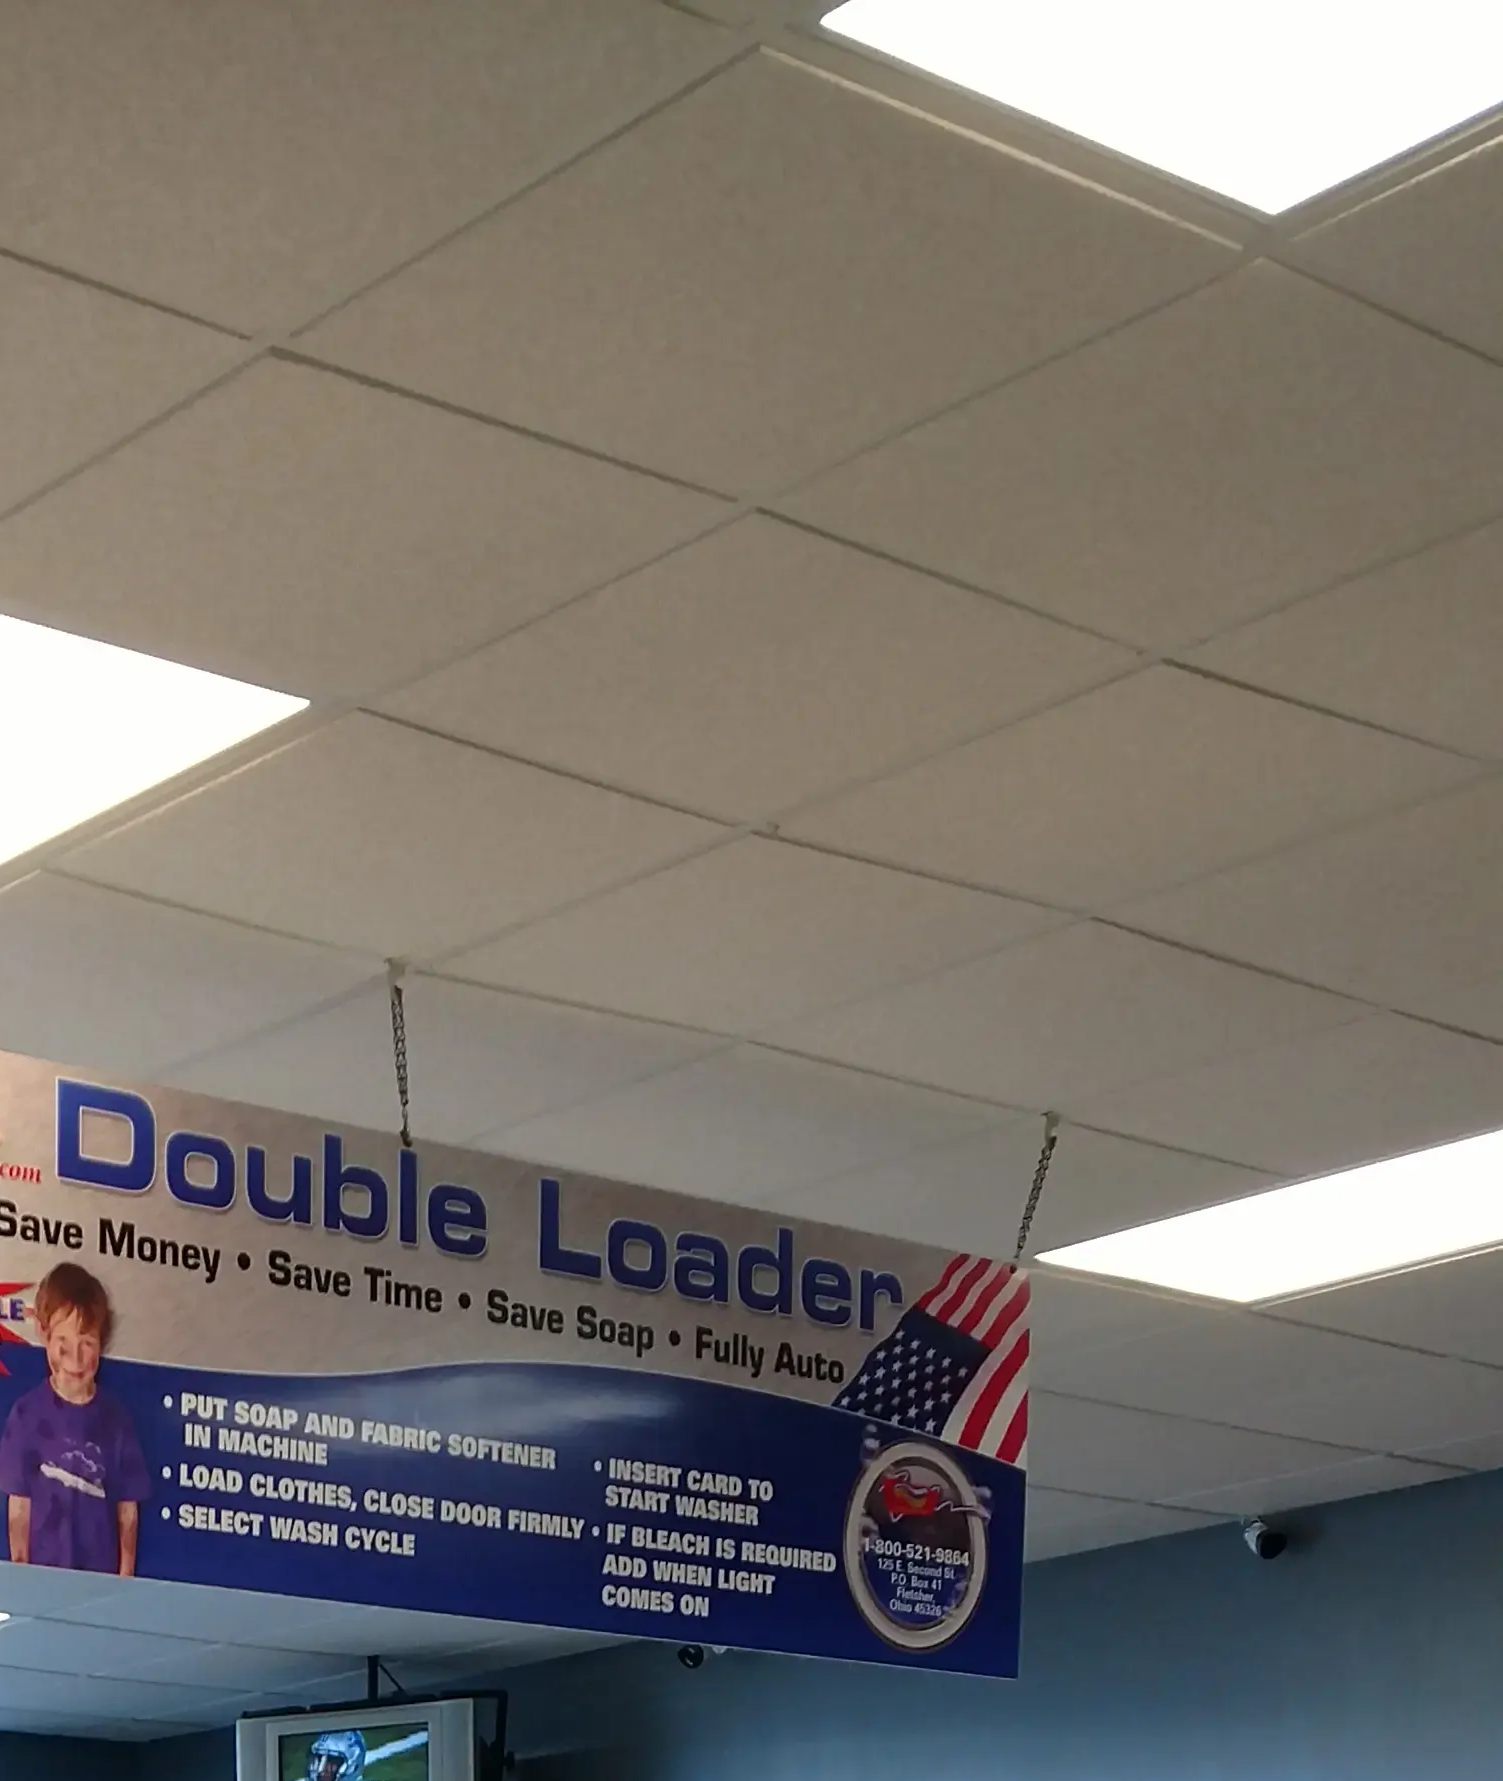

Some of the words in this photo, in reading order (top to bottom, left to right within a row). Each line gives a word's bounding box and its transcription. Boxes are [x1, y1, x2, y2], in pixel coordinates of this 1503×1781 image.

[54, 1075, 488, 1258] Double
[537, 1176, 903, 1332] Loader
[97, 1217, 220, 1283] Money
[267, 1250, 351, 1299] Save
[363, 1267, 443, 1313] Time
[487, 1289, 564, 1337] Save
[575, 1305, 655, 1358] Soap
[696, 1326, 764, 1380] Fully
[774, 1341, 845, 1384] Auto
[180, 1392, 228, 1420] PUT
[234, 1400, 298, 1431] SOAP
[305, 1412, 354, 1439] AND
[361, 1419, 441, 1454] FABRIC
[447, 1432, 556, 1469] SOFTENER
[184, 1423, 210, 1449] IN
[218, 1429, 328, 1466] MACHINE
[179, 1463, 243, 1494] LOAD
[249, 1472, 357, 1512] CLOTHES,
[363, 1489, 434, 1520] CLOSE
[440, 1499, 502, 1528] DOOR
[507, 1508, 585, 1540] FIRMLY
[609, 1458, 682, 1488] INSERT
[687, 1470, 742, 1497] CARD
[748, 1479, 773, 1502] TO
[605, 1485, 670, 1514] START
[675, 1495, 759, 1526] WASHER
[178, 1504, 263, 1537] SELECT
[270, 1516, 338, 1547] WASH
[345, 1526, 416, 1556] CYCLE
[607, 1523, 626, 1545] IF
[632, 1526, 710, 1556] BLEACH
[715, 1537, 735, 1560] IS
[741, 1541, 837, 1572] REQUIRED
[602, 1554, 647, 1578] ADD
[653, 1560, 712, 1587] WHEN
[718, 1569, 776, 1595] LIGHT
[911, 1576, 928, 1588] Box
[932, 1579, 942, 1590] 41
[602, 1585, 674, 1613] COMES
[680, 1594, 709, 1617] ON
[890, 1599, 912, 1613] Ohio
